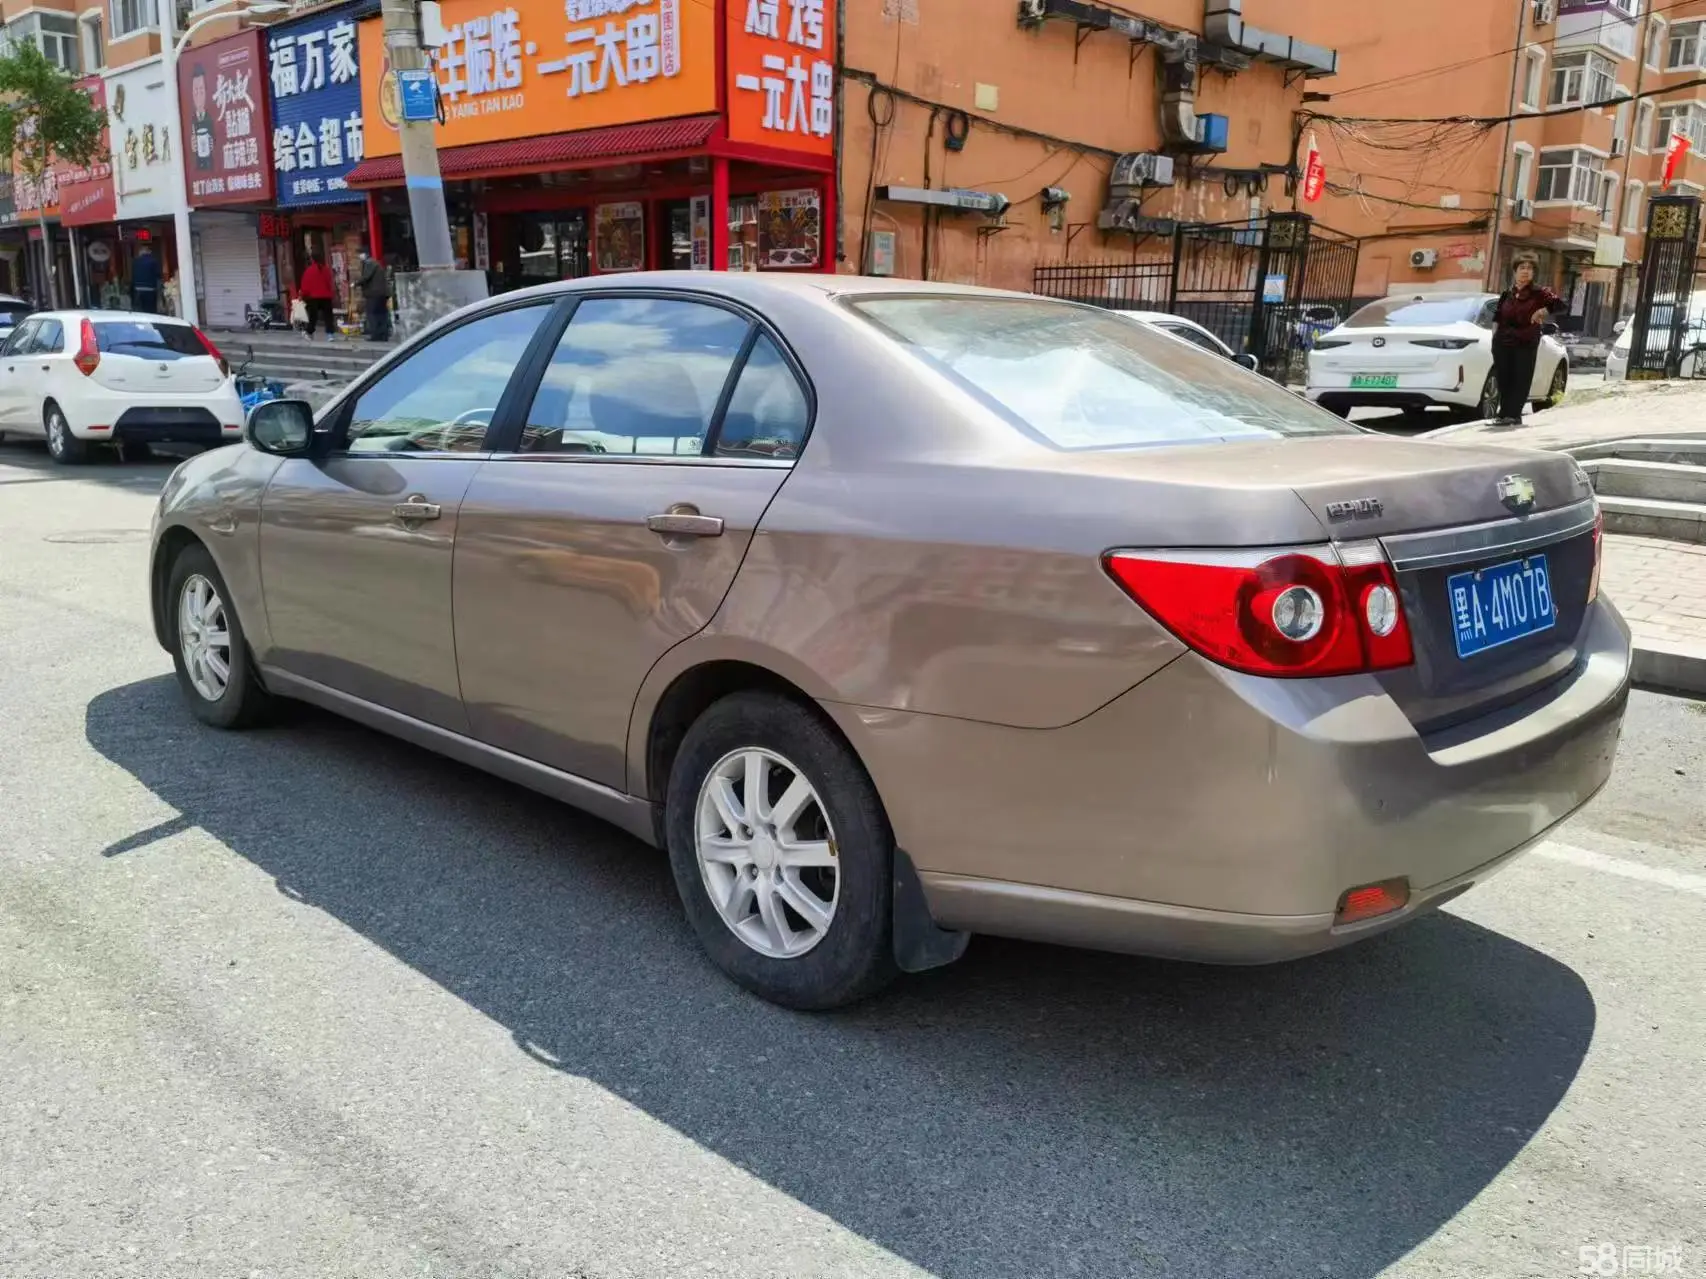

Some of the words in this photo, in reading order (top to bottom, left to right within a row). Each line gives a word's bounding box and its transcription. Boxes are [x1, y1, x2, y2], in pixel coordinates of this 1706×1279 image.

[269, 20, 359, 98] 福万家
[452, 101, 480, 119] YANG
[480, 98, 501, 115] TAN
[502, 93, 524, 112] KAO
[736, 54, 833, 138] 一元大串
[223, 137, 260, 170] 麻辣烫
[273, 110, 364, 172] 综合超市
[1453, 567, 1550, 642] 黑A·4M07B
